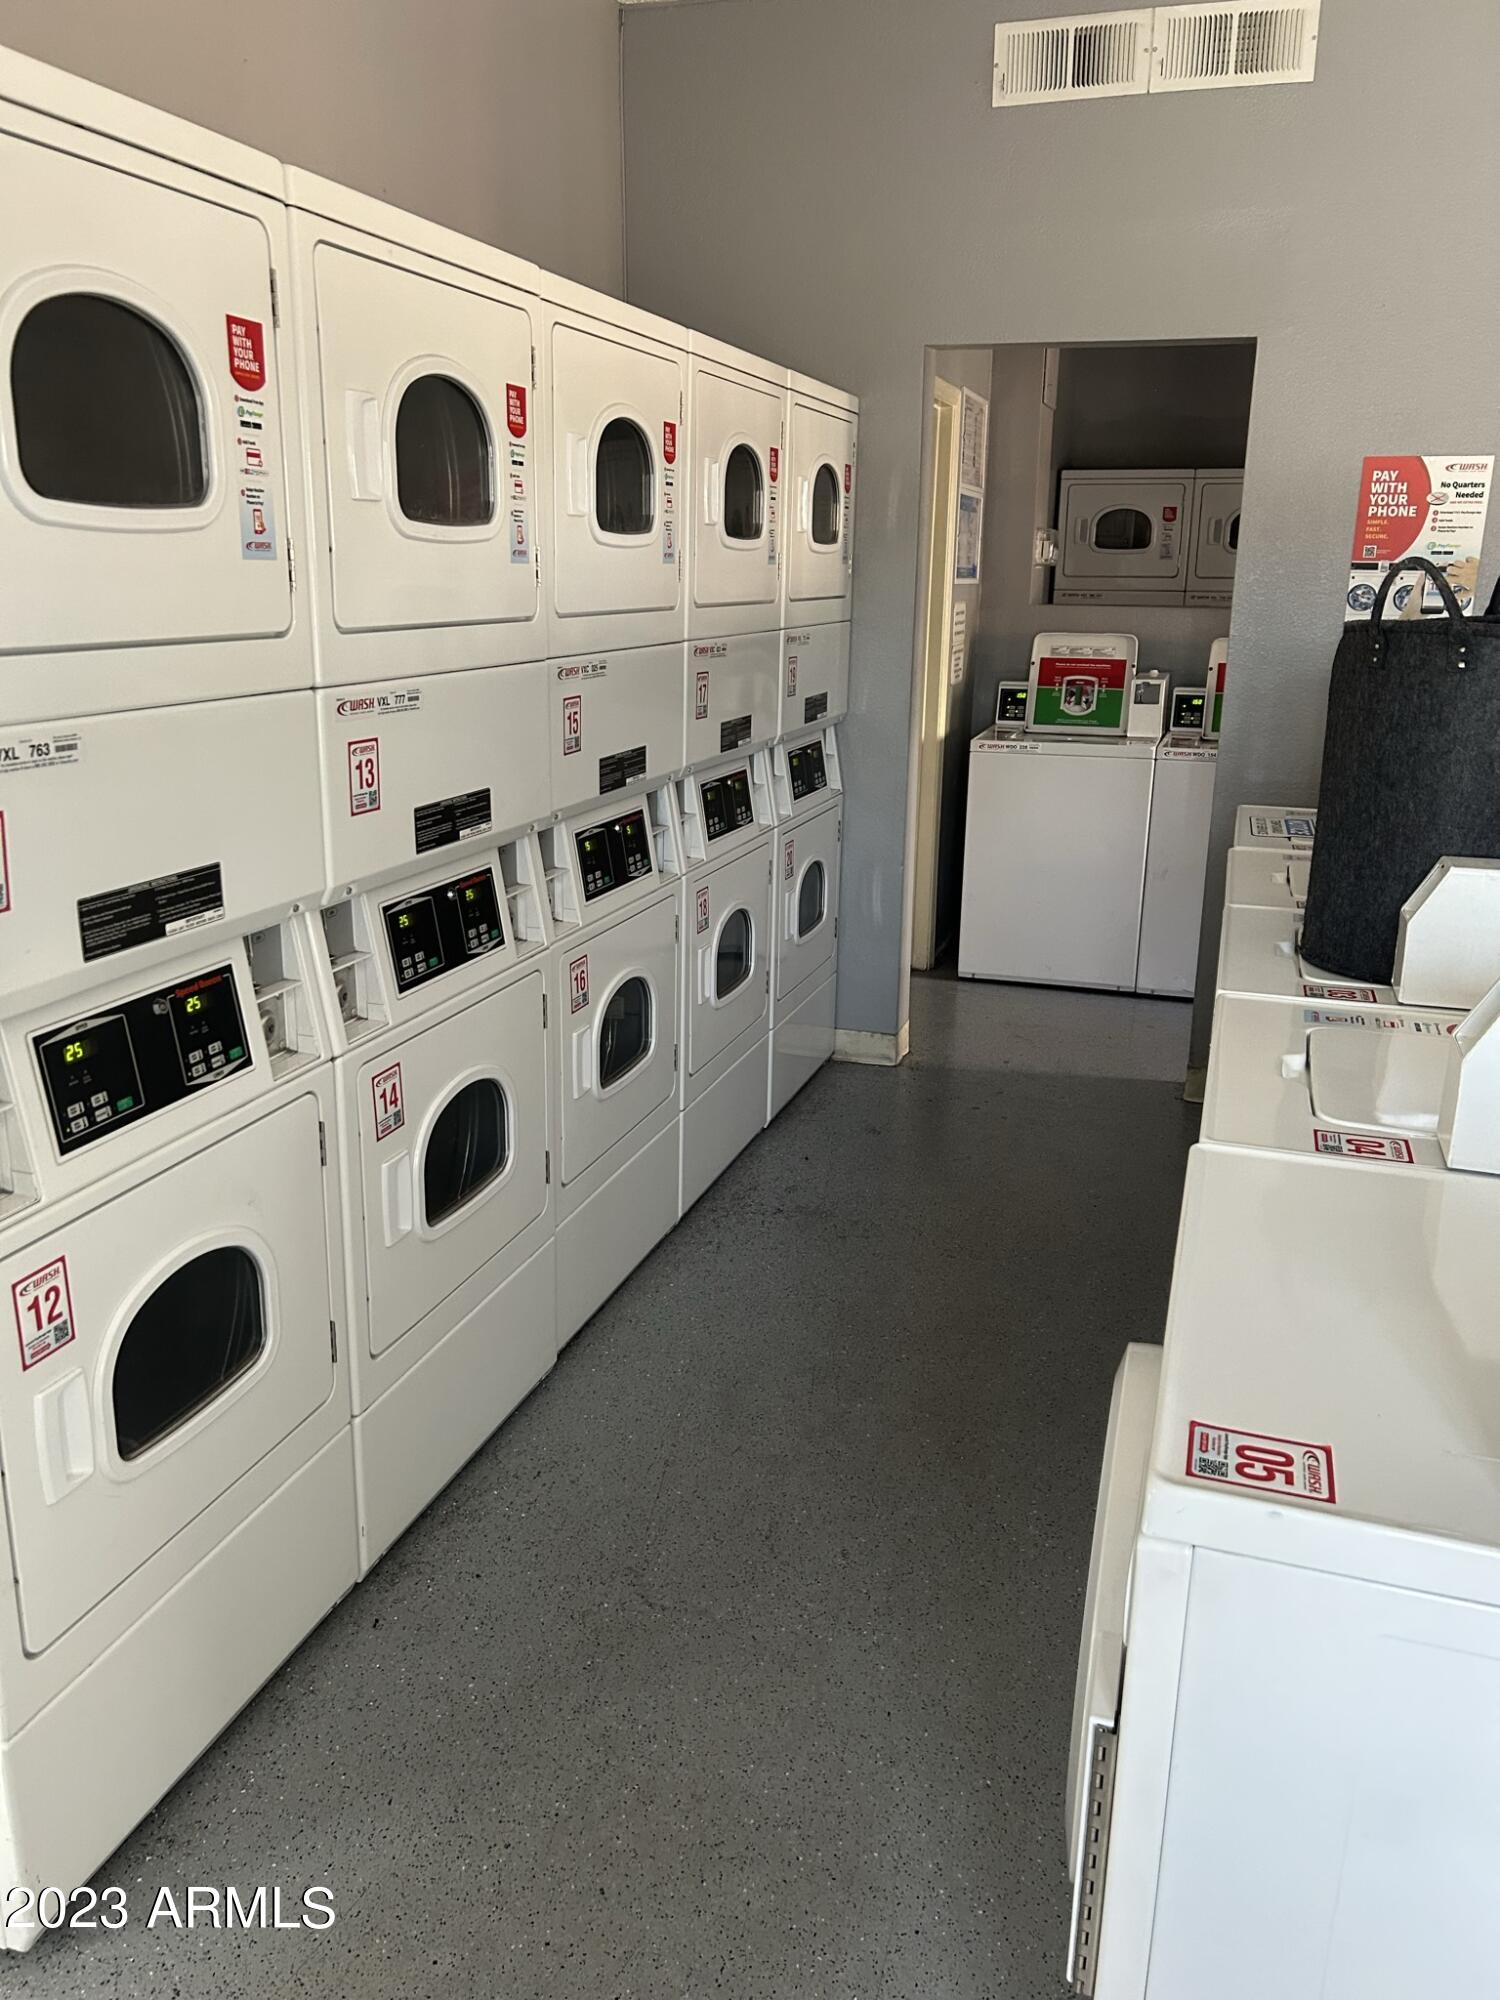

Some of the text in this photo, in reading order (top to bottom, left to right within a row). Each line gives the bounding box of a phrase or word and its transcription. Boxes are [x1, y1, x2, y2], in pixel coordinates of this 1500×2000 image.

[231, 324, 246, 336] PAY
[232, 335, 252, 349] WITH
[233, 346, 254, 360] YOUR
[234, 357, 260, 372] PHONE
[1372, 470, 1399, 481] PAY
[1371, 482, 1408, 493] WITH
[1440, 481, 1486, 490] No Quarters
[1369, 494, 1408, 505] YOUR
[1455, 491, 1484, 499] Needed
[1367, 505, 1418, 517] PHONE
[698, 683, 707, 703] 17
[350, 698, 375, 711] WASH
[377, 696, 390, 707] VXL
[394, 694, 406, 704] 777
[567, 711, 579, 735] 15
[29, 743, 50, 757] 763
[355, 758, 375, 789] 13
[574, 969, 586, 994] 16
[186, 996, 201, 1012] 25
[66, 1042, 83, 1062] 25
[380, 1082, 399, 1114] 14
[1346, 1139, 1386, 1156] 04
[27, 1285, 63, 1332] 12
[1235, 1444, 1295, 1486] 05
[1307, 1464, 1323, 1494] WASH
